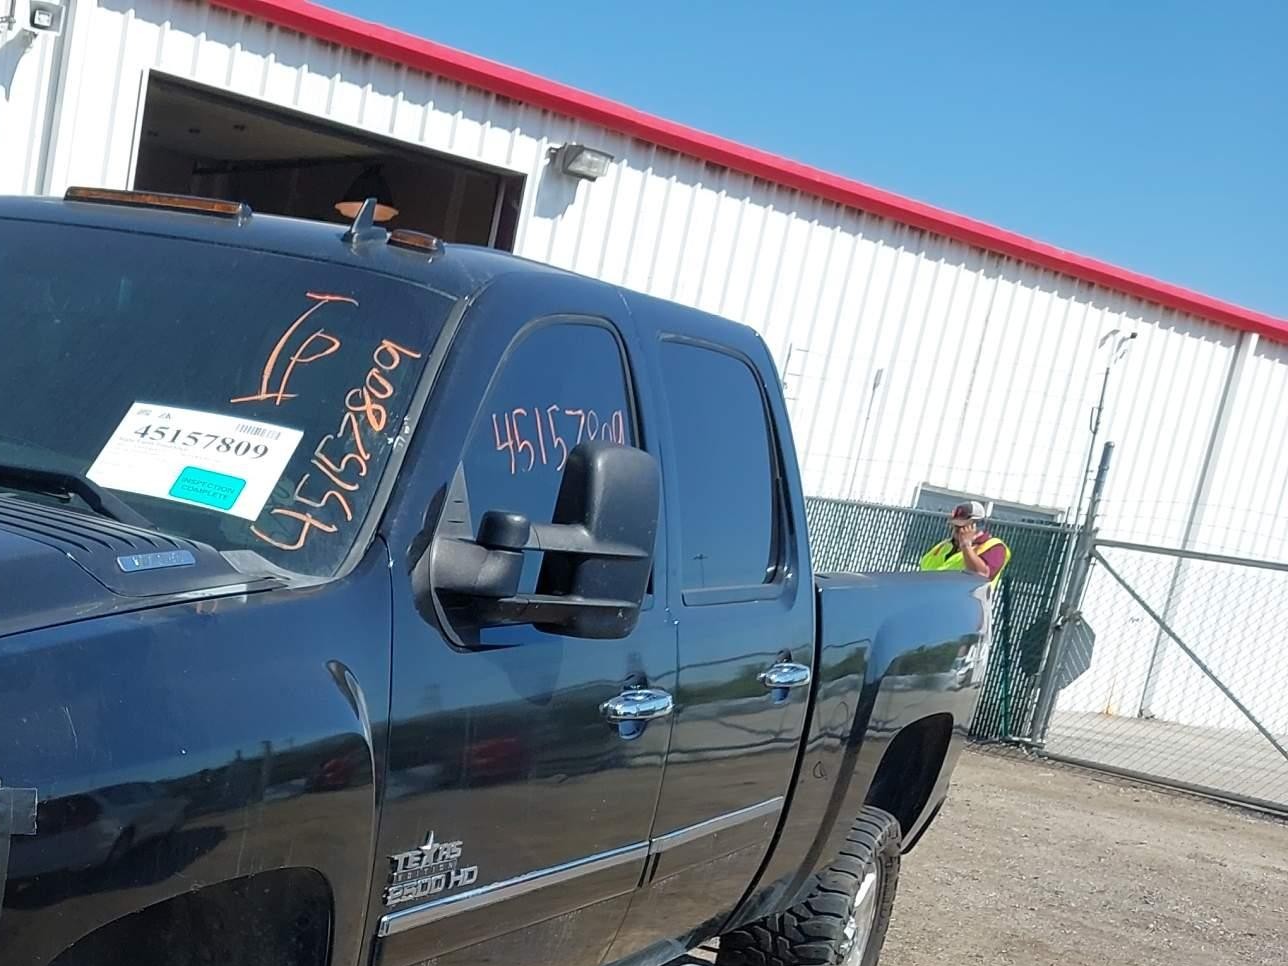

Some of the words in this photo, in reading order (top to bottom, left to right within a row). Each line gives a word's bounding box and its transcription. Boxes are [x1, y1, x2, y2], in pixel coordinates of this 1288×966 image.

[134, 424, 269, 460] 45157809
[250, 338, 422, 551] 45157809
[180, 484, 229, 500] COMPLETE
[181, 476, 236, 494] INSPECTION
[390, 831, 463, 870] TEXAS
[385, 874, 446, 906] 2500
[447, 865, 478, 890] HD
